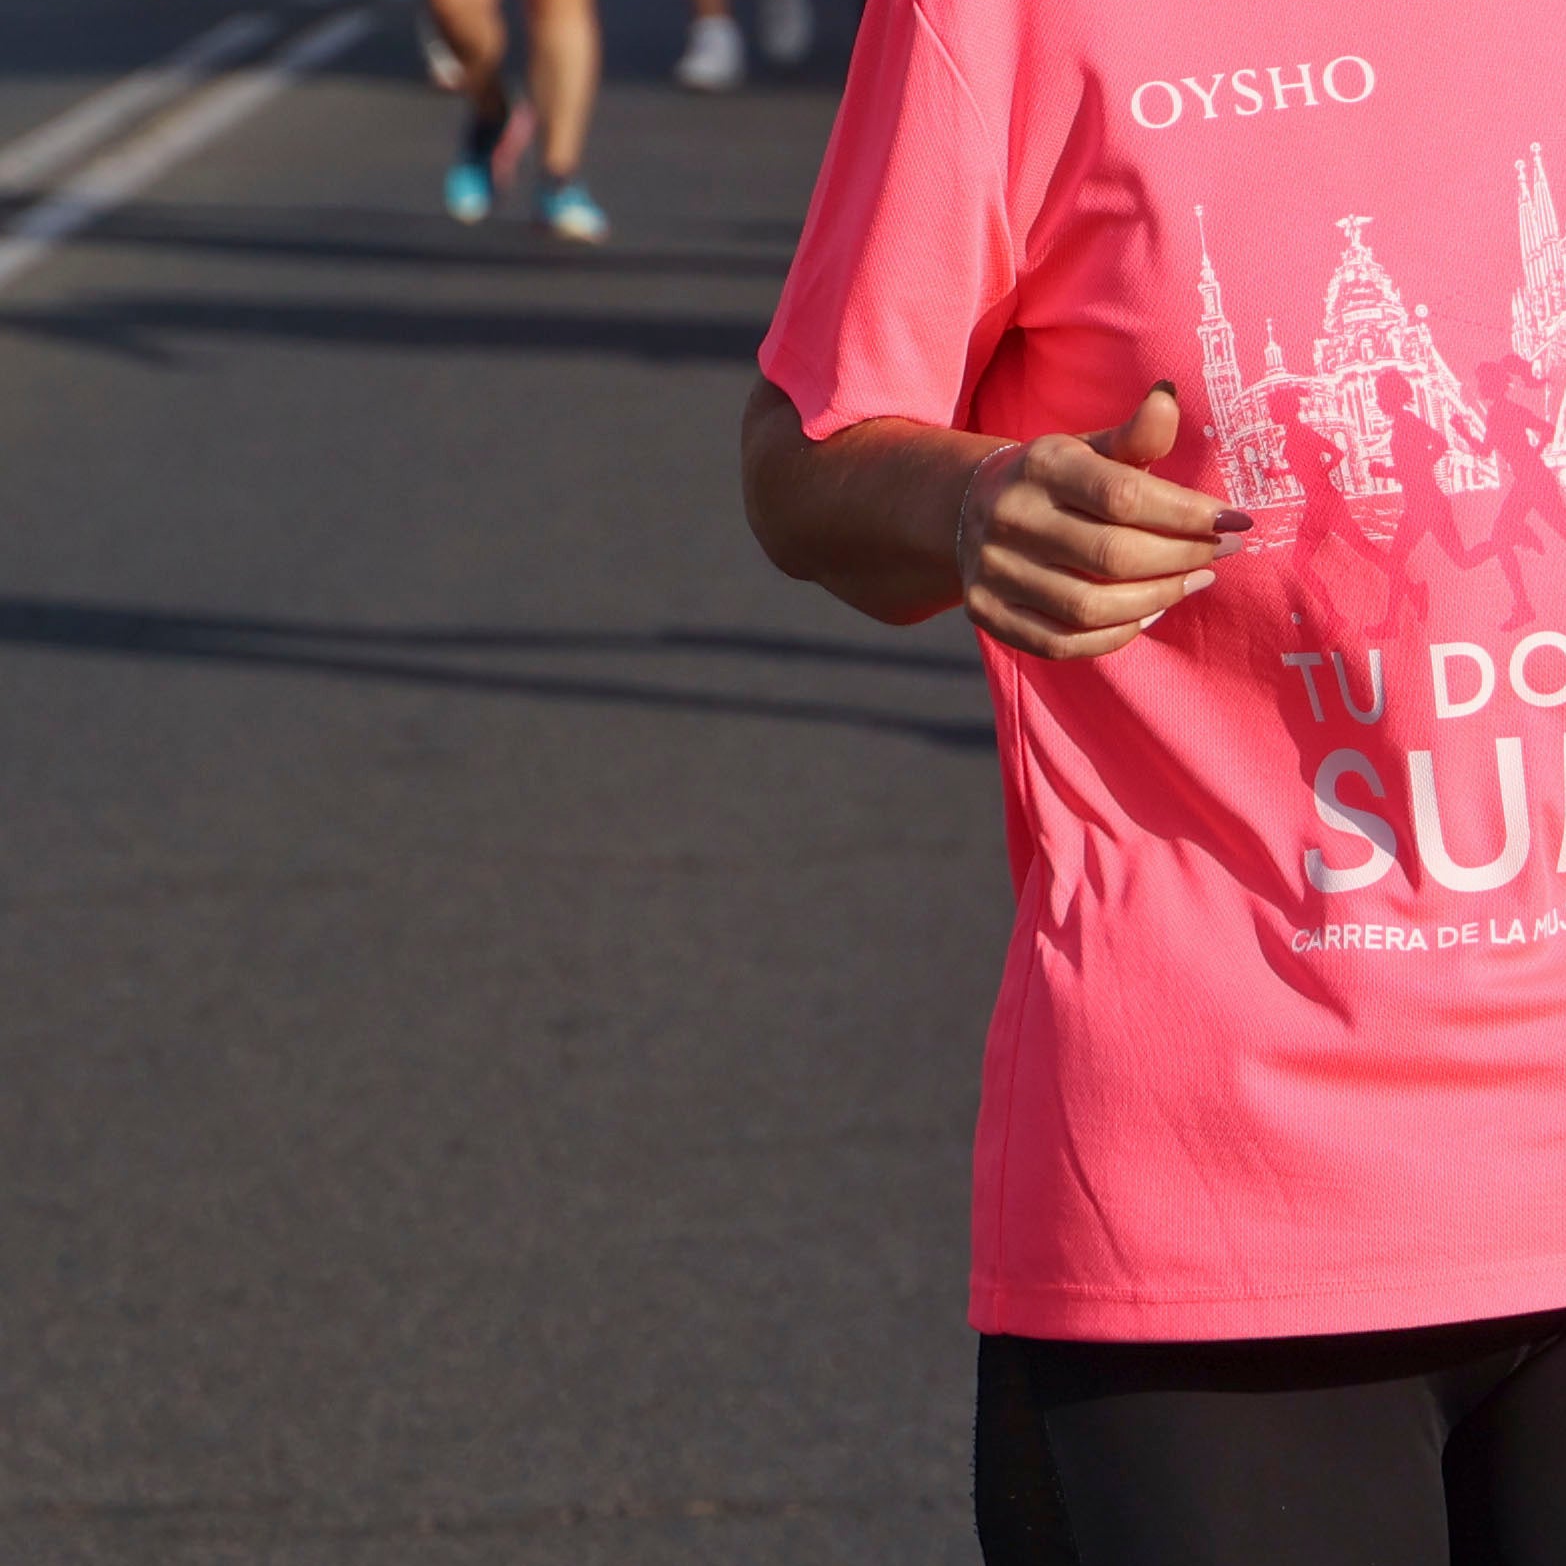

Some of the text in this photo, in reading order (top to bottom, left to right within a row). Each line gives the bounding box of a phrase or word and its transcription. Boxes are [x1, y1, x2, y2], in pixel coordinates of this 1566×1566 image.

[1131, 55, 1375, 129] OYSHO
[1281, 648, 1385, 724] TU
[1290, 923, 1429, 953] CARRERA
[1437, 922, 1479, 949] DE
[1489, 918, 1526, 945] LA
